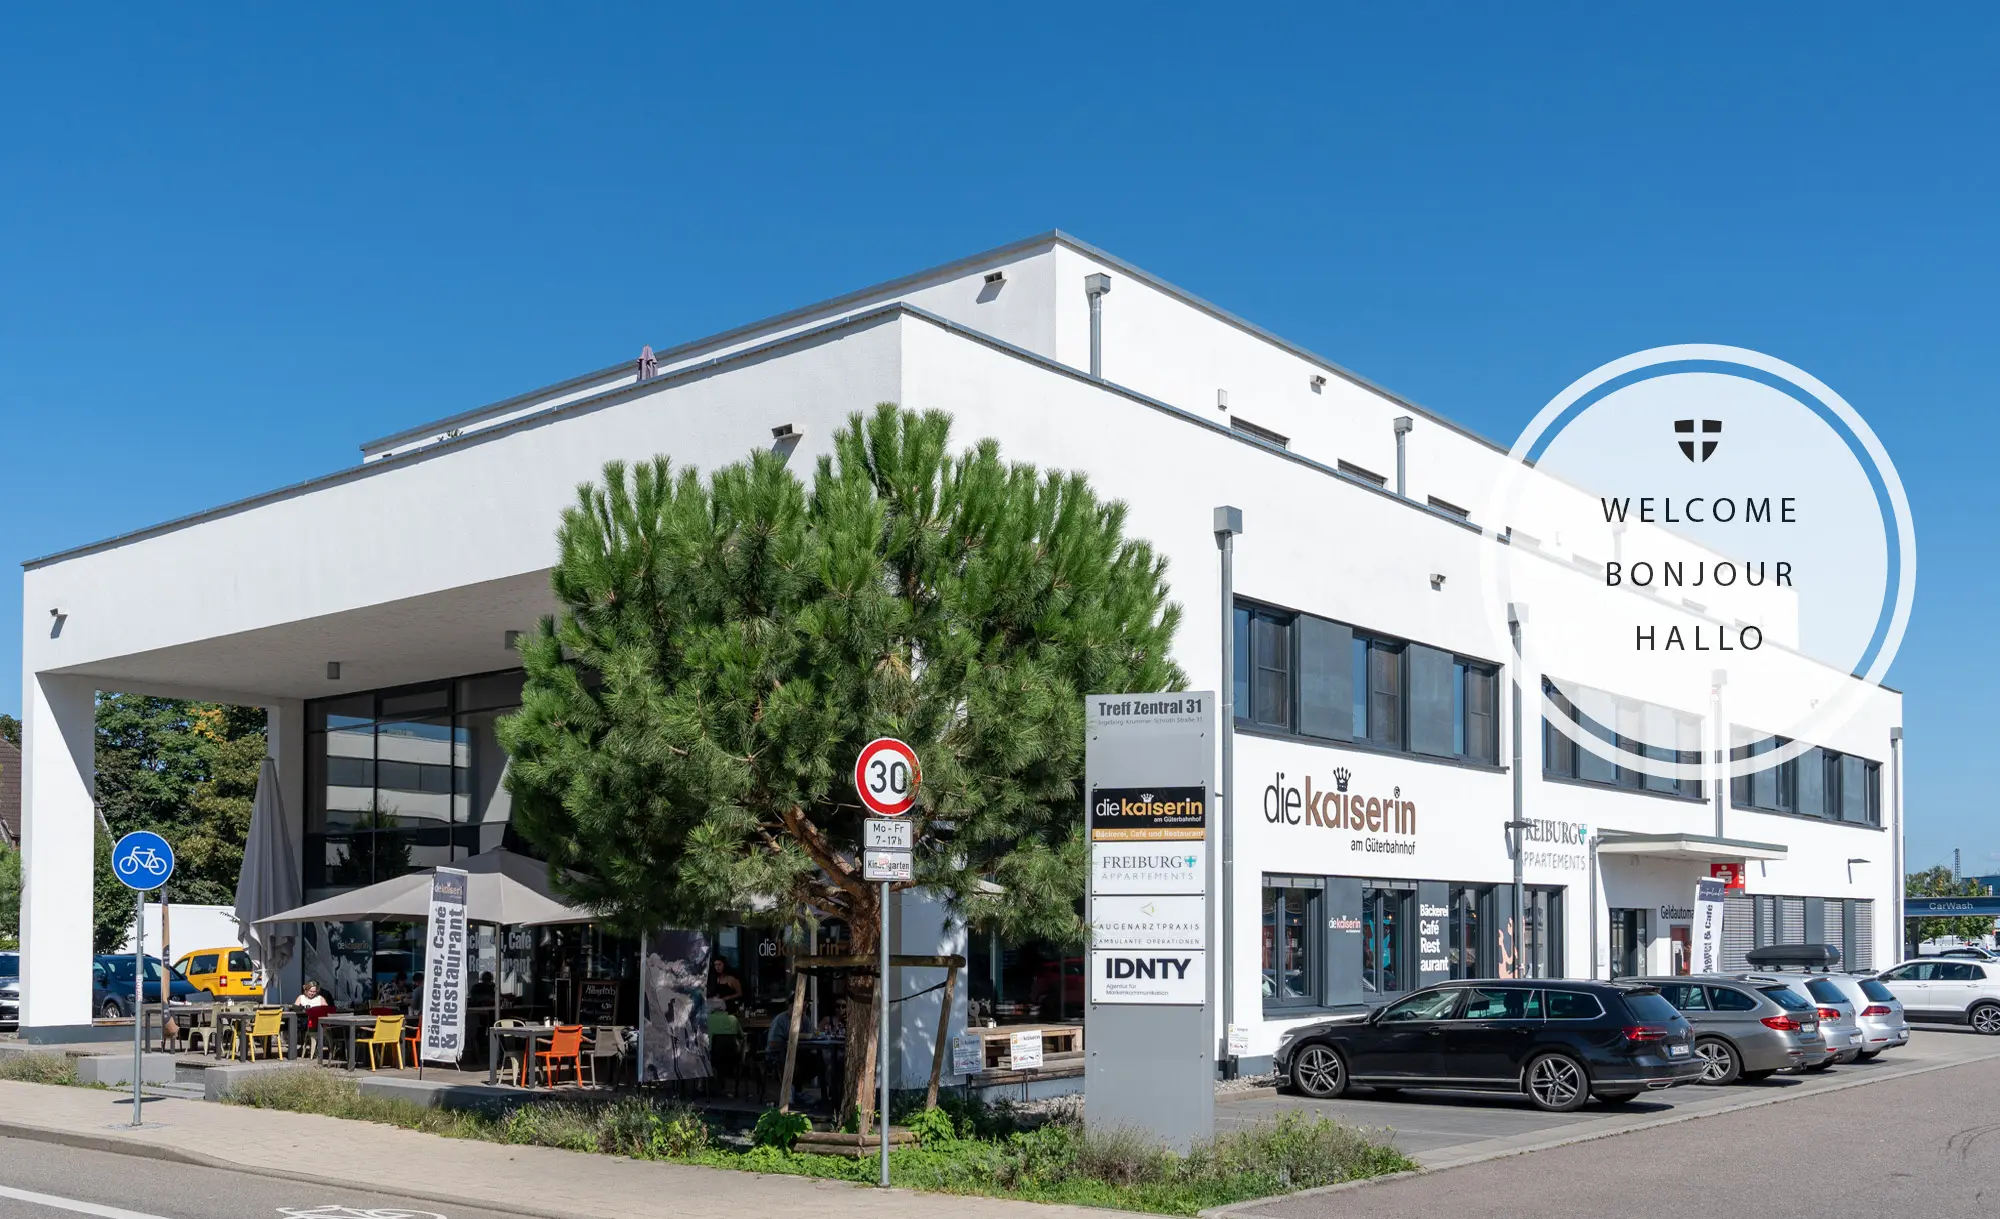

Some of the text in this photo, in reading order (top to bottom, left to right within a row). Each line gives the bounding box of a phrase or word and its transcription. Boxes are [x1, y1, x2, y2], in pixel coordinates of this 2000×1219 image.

[1098, 699, 1202, 717] Treff Zentral 31
[870, 760, 908, 794] 30
[873, 823, 886, 833] Mo
[894, 824, 904, 833] Fr
[1095, 830, 1128, 838] Bäckerei,
[1351, 837, 1416, 856] am Güterbahnhof
[1102, 855, 1182, 869] FREIBURG
[1523, 851, 1586, 871] PPARTEMENTS
[1101, 872, 1194, 880] APPARTEMENTS
[1420, 903, 1449, 918] Bäckerei
[1929, 902, 1974, 910] CarWash
[1098, 922, 1200, 931] AUGENARZTPRAXIS
[1420, 919, 1440, 936] Café
[508, 928, 532, 950] Café
[1420, 938, 1441, 954] Rest
[441, 908, 463, 1027] Restaurant
[1106, 958, 1192, 979] IDNTY
[1420, 956, 1449, 972] aurant
[428, 905, 447, 1049] Bäckerei, Café
[440, 1034, 458, 1050] &
